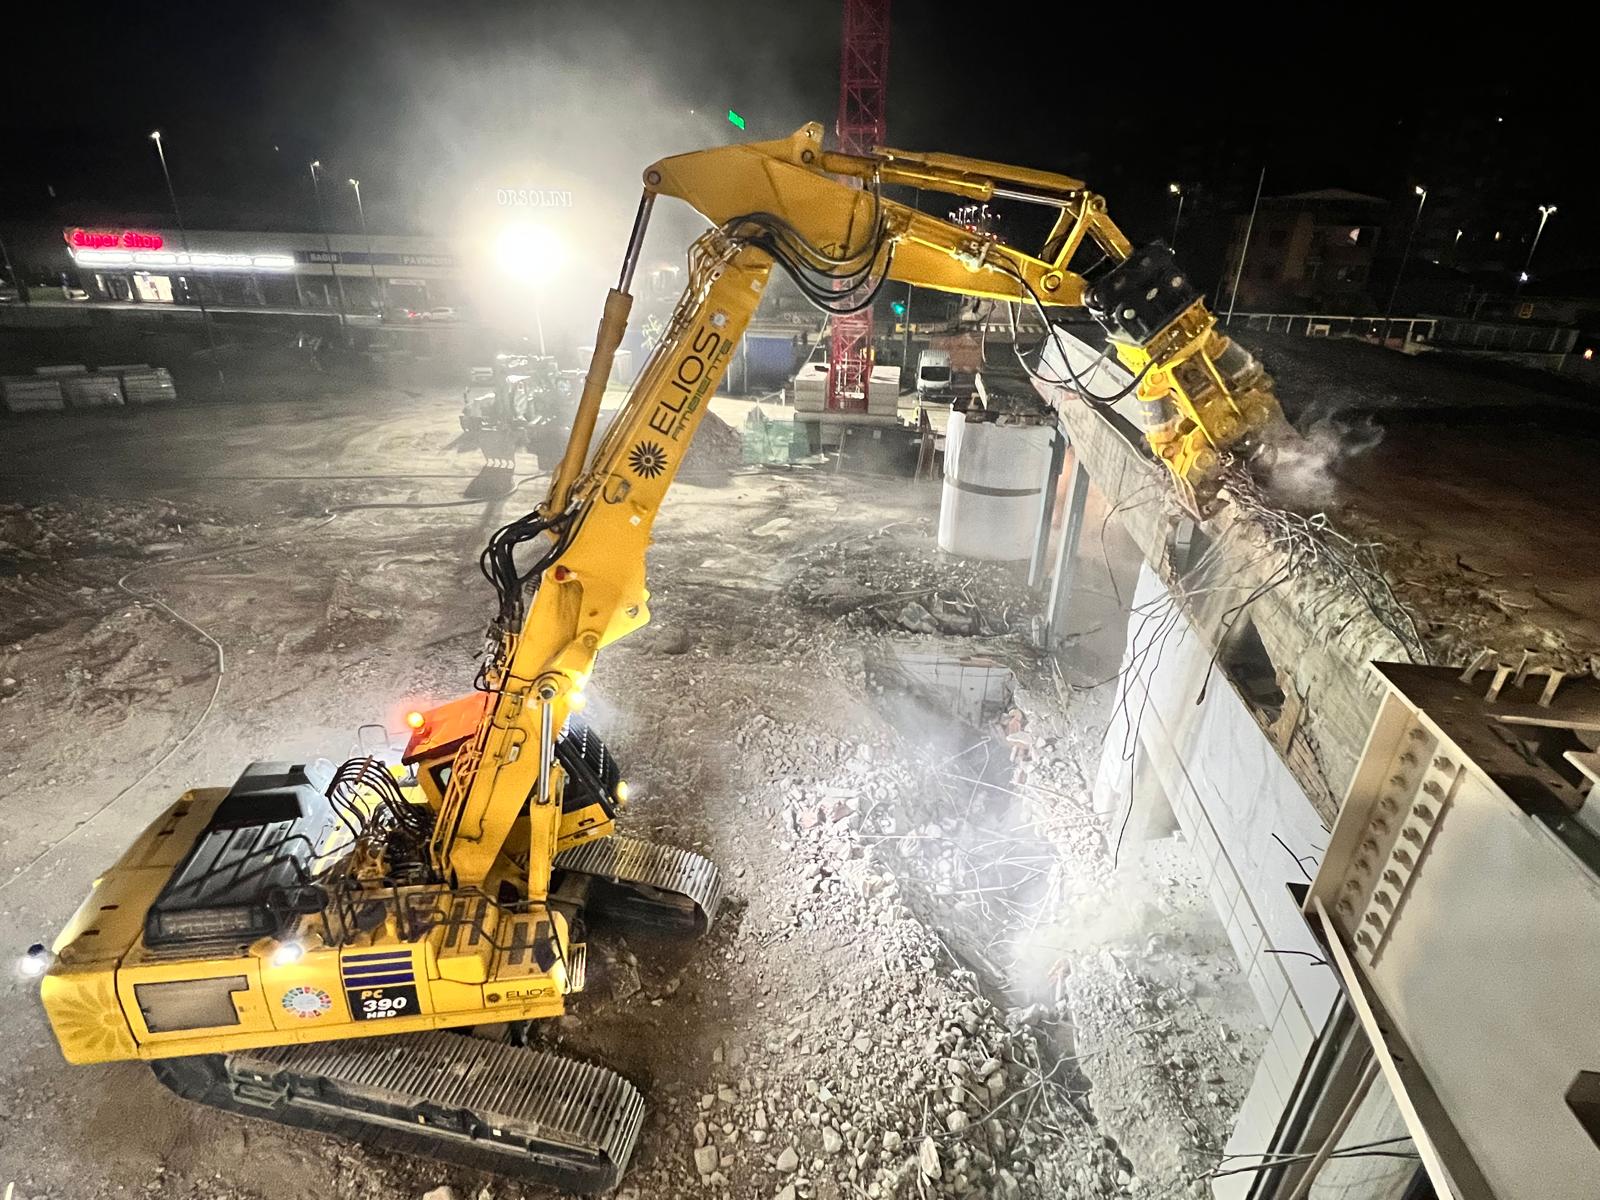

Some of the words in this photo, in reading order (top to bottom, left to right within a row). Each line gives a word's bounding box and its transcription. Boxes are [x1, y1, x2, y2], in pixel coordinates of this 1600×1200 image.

[497, 189, 573, 207] ORSOLINI
[73, 231, 118, 248] Super
[123, 231, 163, 250] Shop
[649, 326, 721, 436] ELIOS
[361, 989, 384, 1000] PC
[505, 986, 555, 999] ELIOS
[362, 996, 407, 1012] 390
